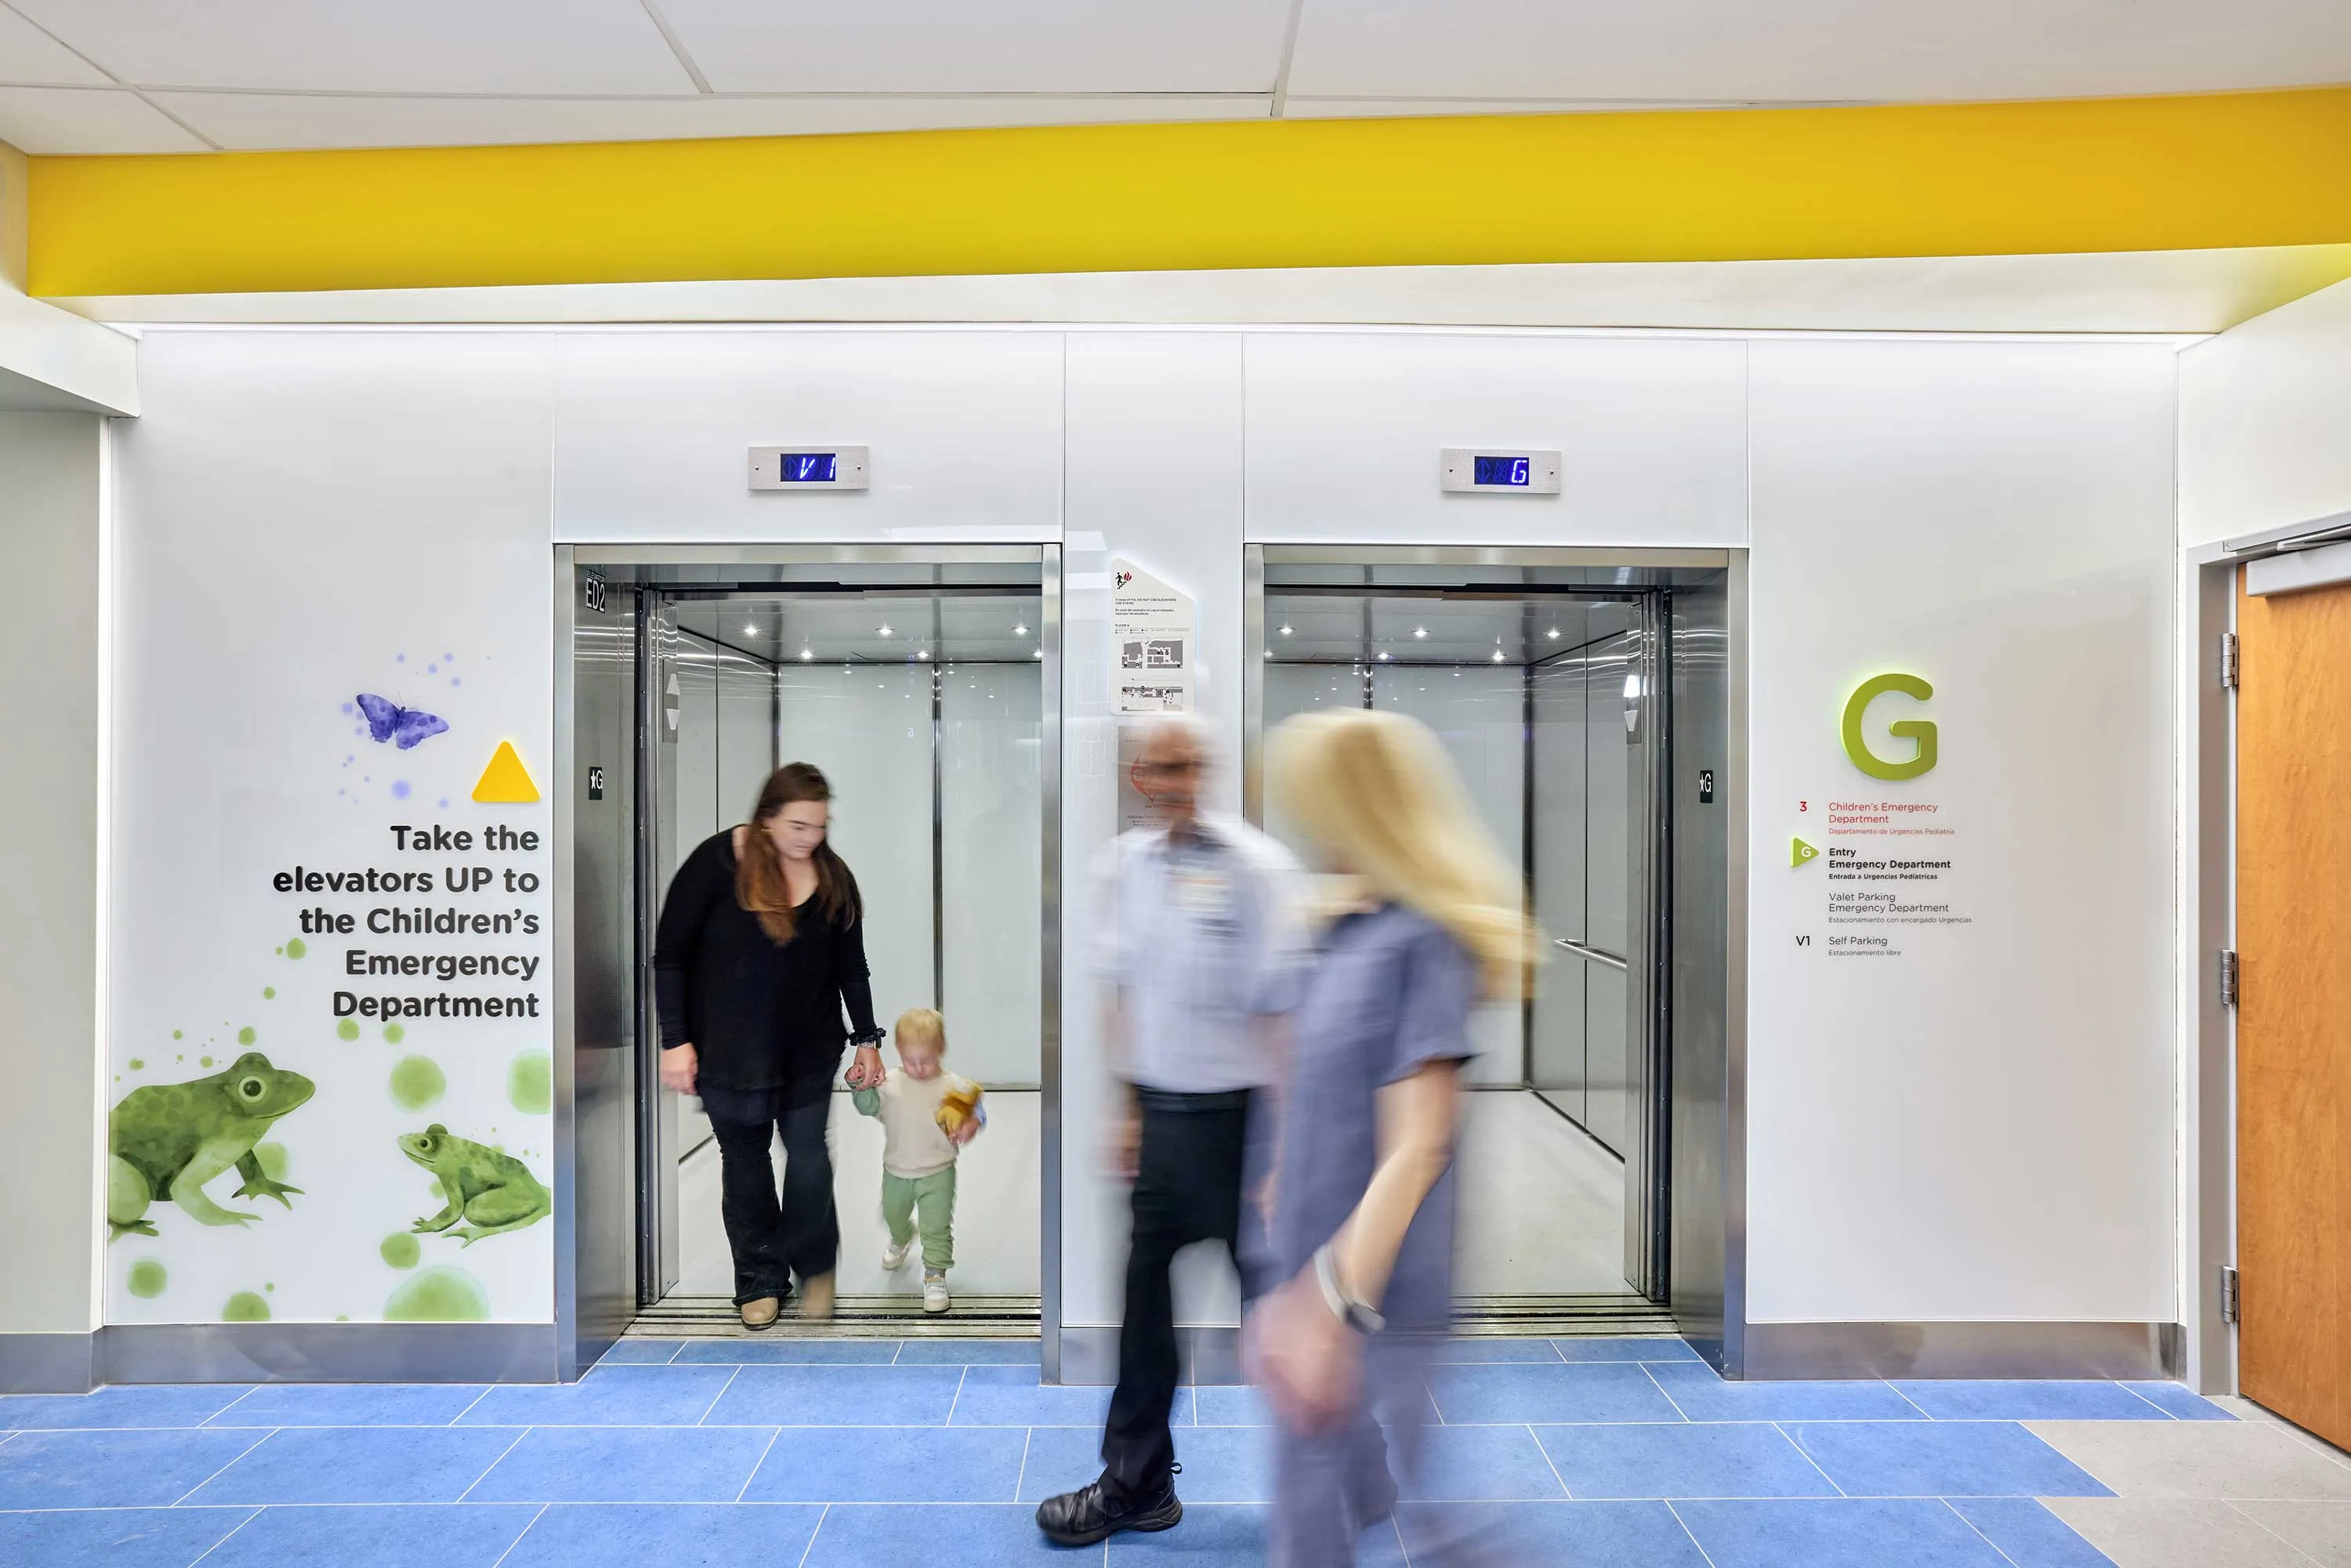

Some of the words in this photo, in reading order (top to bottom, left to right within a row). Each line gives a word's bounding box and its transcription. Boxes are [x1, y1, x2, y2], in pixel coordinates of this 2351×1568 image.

[1511, 459, 1527, 483] G
[586, 578, 605, 613] ED2
[1840, 673, 1937, 781] G
[596, 770, 603, 790] G
[1704, 773, 1712, 793] G
[1799, 801, 1807, 812] 3
[1829, 802, 1879, 812] Children's
[1882, 802, 1939, 814] Emergency
[1829, 814, 1889, 824] Department
[1889, 827, 1923, 836] Urgencias
[389, 824, 473, 851] Take
[484, 824, 540, 852] the
[1801, 846, 1812, 858] G
[1829, 848, 1857, 858] Entry
[1829, 860, 1887, 870] Emergency
[1889, 860, 1951, 870] Department
[273, 865, 433, 893] elevators
[445, 867, 493, 893] UP
[502, 867, 540, 893] to
[1829, 892, 1855, 902] Valet
[1858, 892, 1896, 903] Parking
[1829, 903, 1886, 914] Emergency
[1889, 903, 1950, 914] Department
[299, 907, 356, 934] the
[367, 907, 540, 935] Children's
[1795, 936, 1810, 947] V1
[1829, 936, 1848, 946] Self
[1851, 936, 1888, 947] Parking
[346, 949, 540, 982] Emergency
[333, 990, 540, 1023] Department
